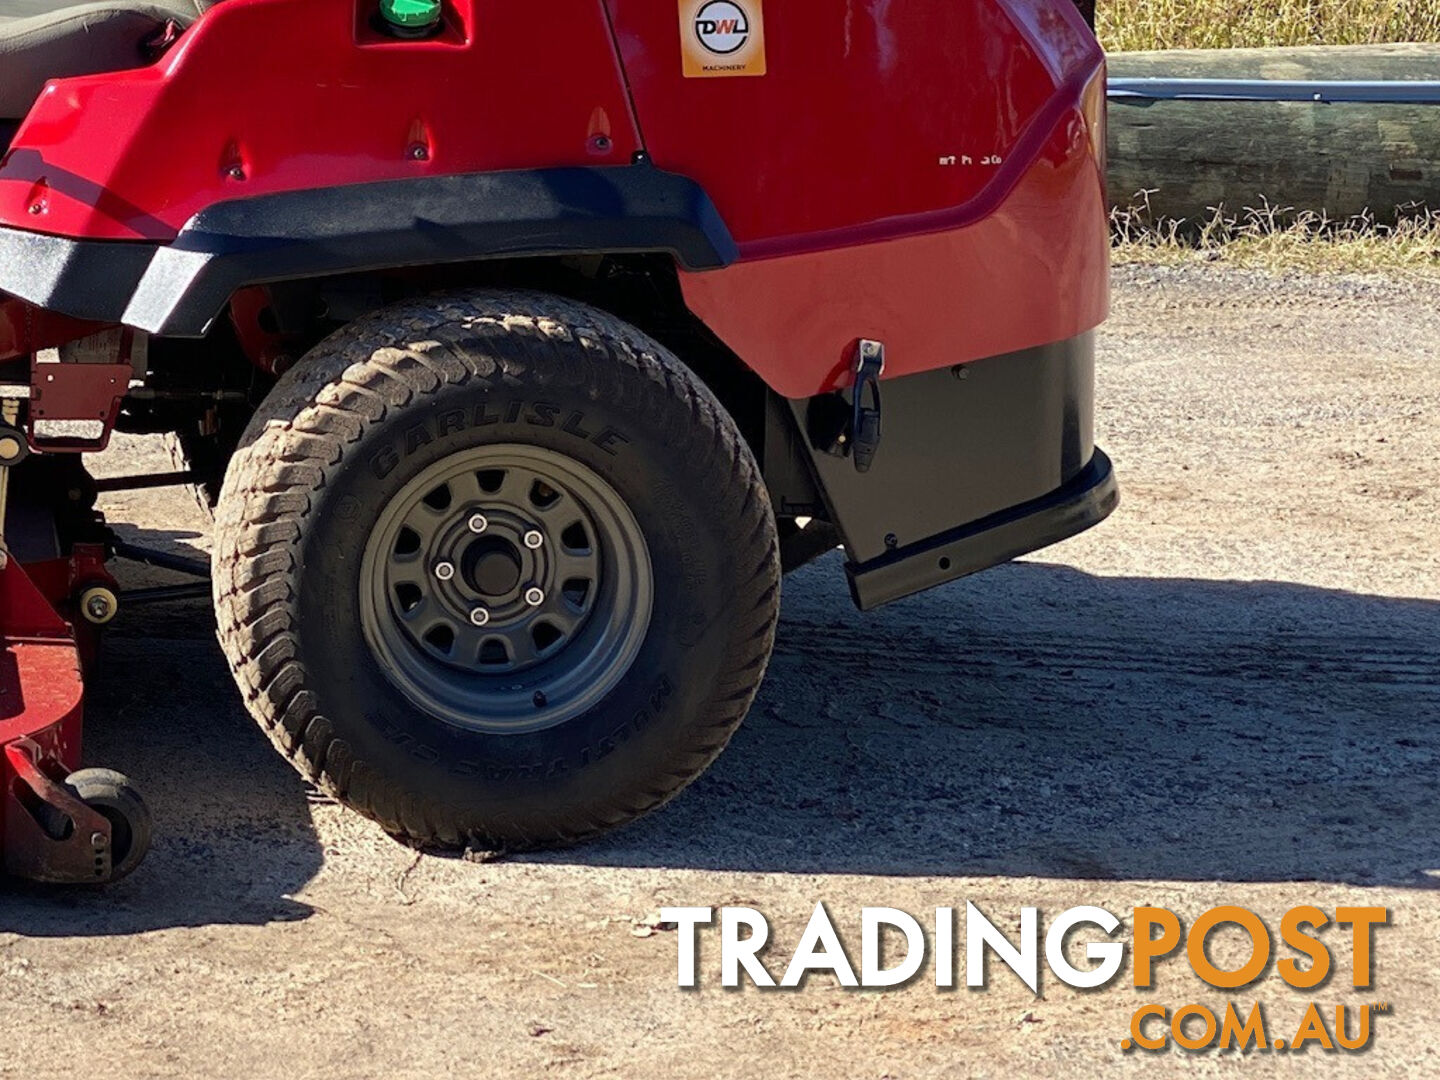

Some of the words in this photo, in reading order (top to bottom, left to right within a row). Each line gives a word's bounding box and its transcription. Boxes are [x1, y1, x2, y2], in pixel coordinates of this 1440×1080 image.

[696, 19, 748, 35] DWL
[702, 63, 746, 72] MACHINERY
[368, 399, 629, 480] CARLISLE
